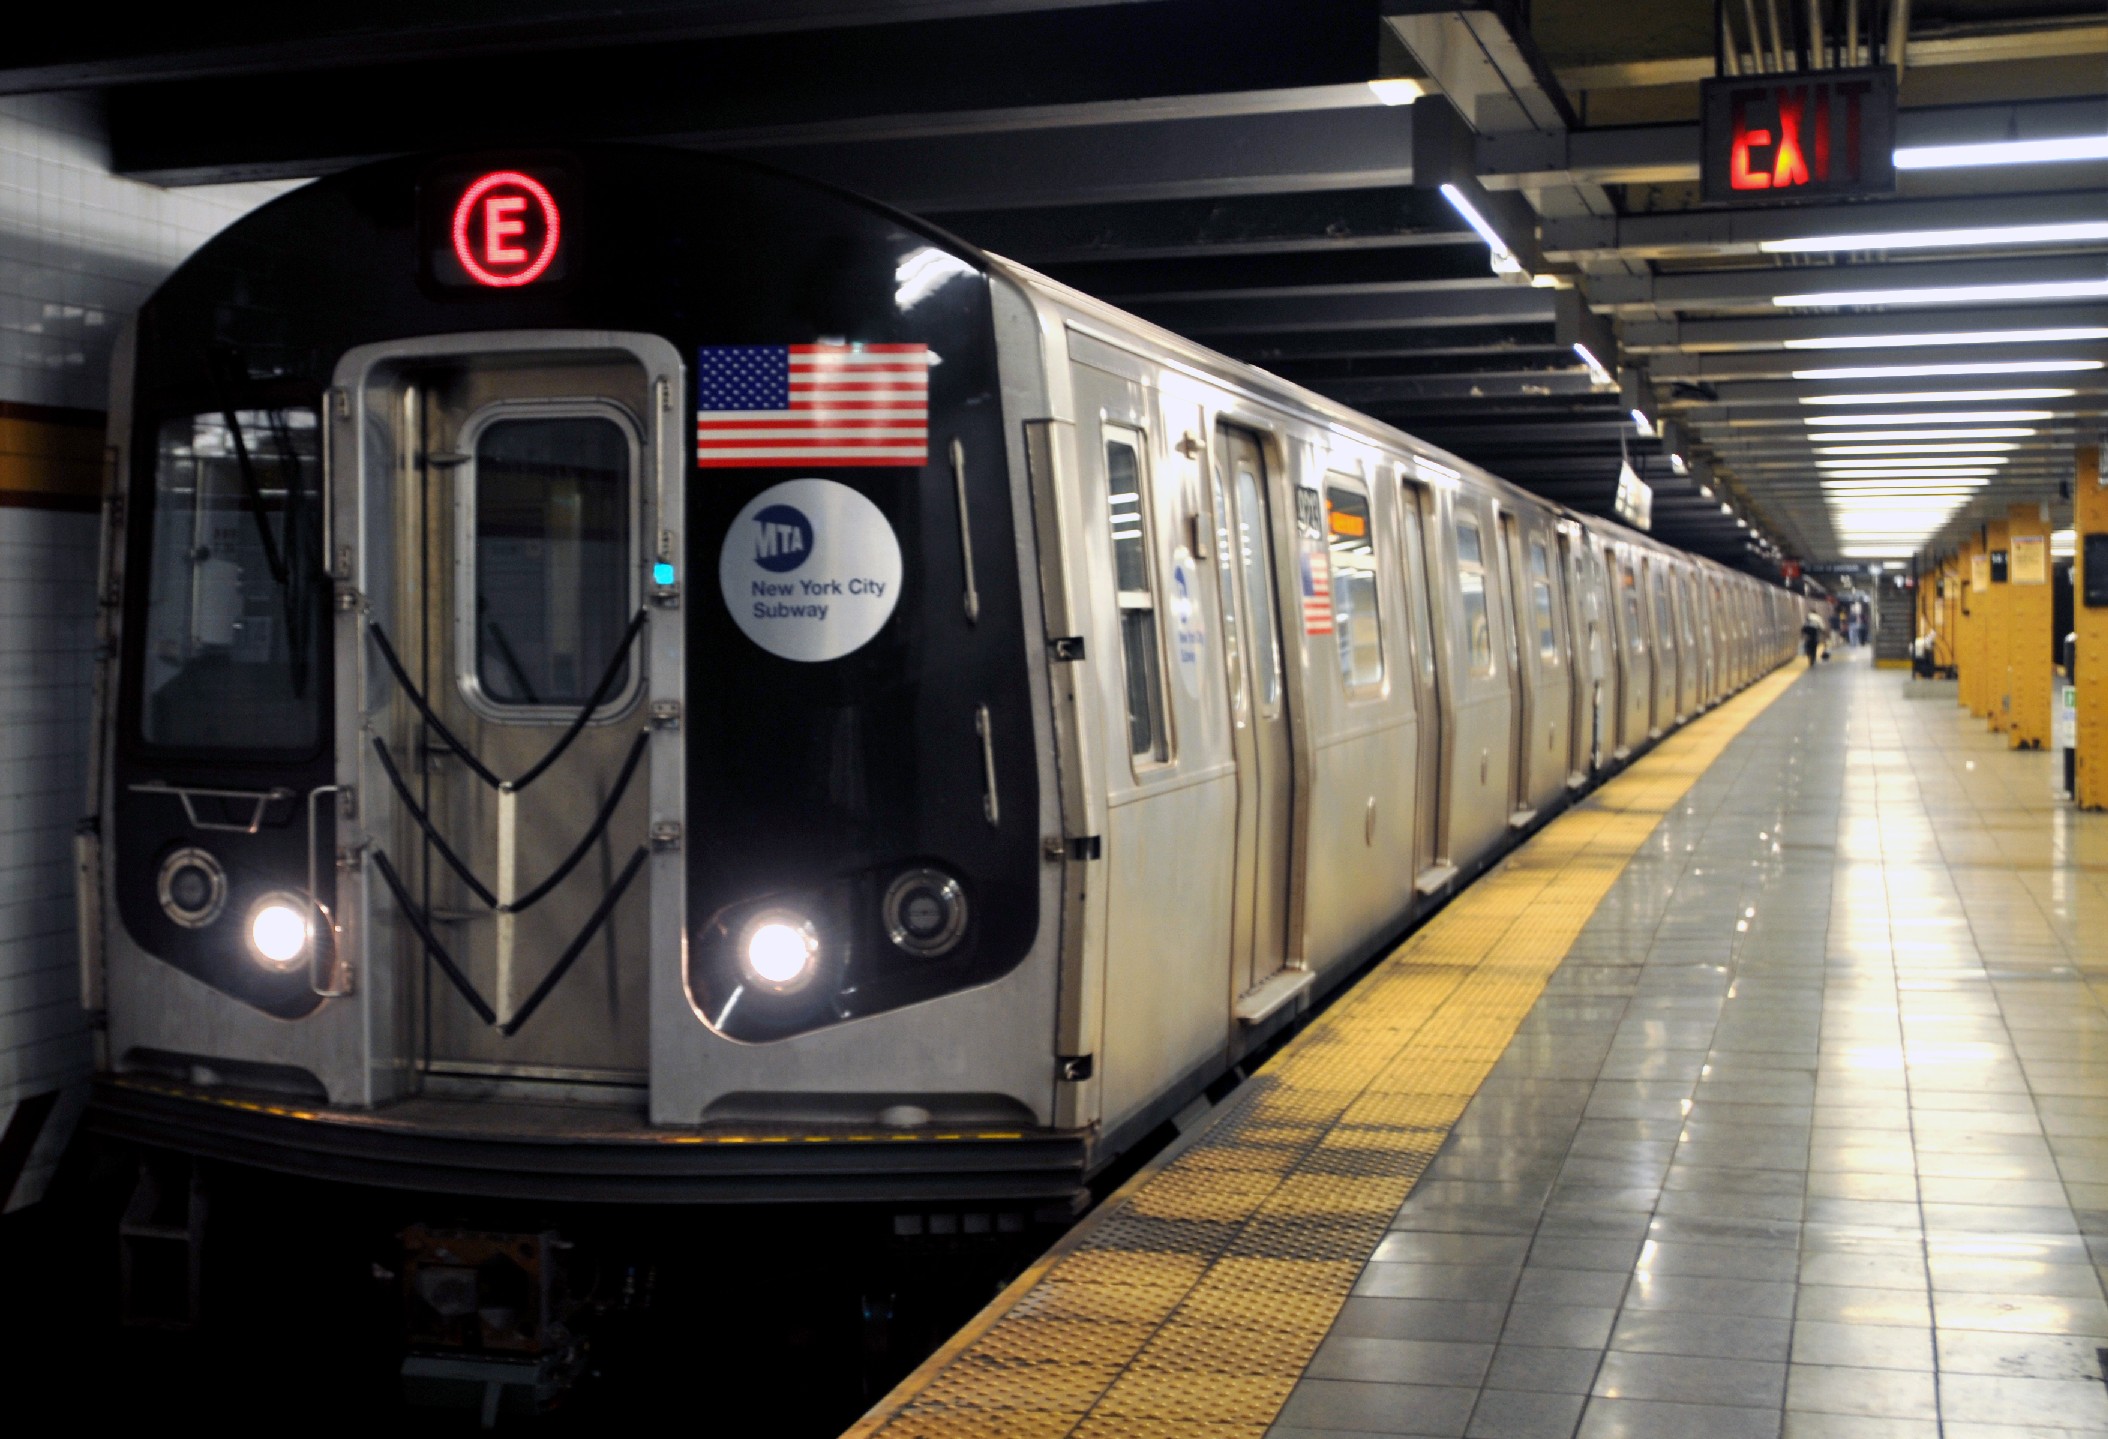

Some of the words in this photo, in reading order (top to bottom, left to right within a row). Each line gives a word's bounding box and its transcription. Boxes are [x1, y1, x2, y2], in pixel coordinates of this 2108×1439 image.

[1730, 80, 1871, 190] EXIT
[484, 197, 528, 263] E
[751, 518, 805, 560] MTA
[751, 580, 794, 597] New
[800, 579, 842, 597] York
[848, 577, 887, 598] City
[753, 601, 828, 621] Subway
